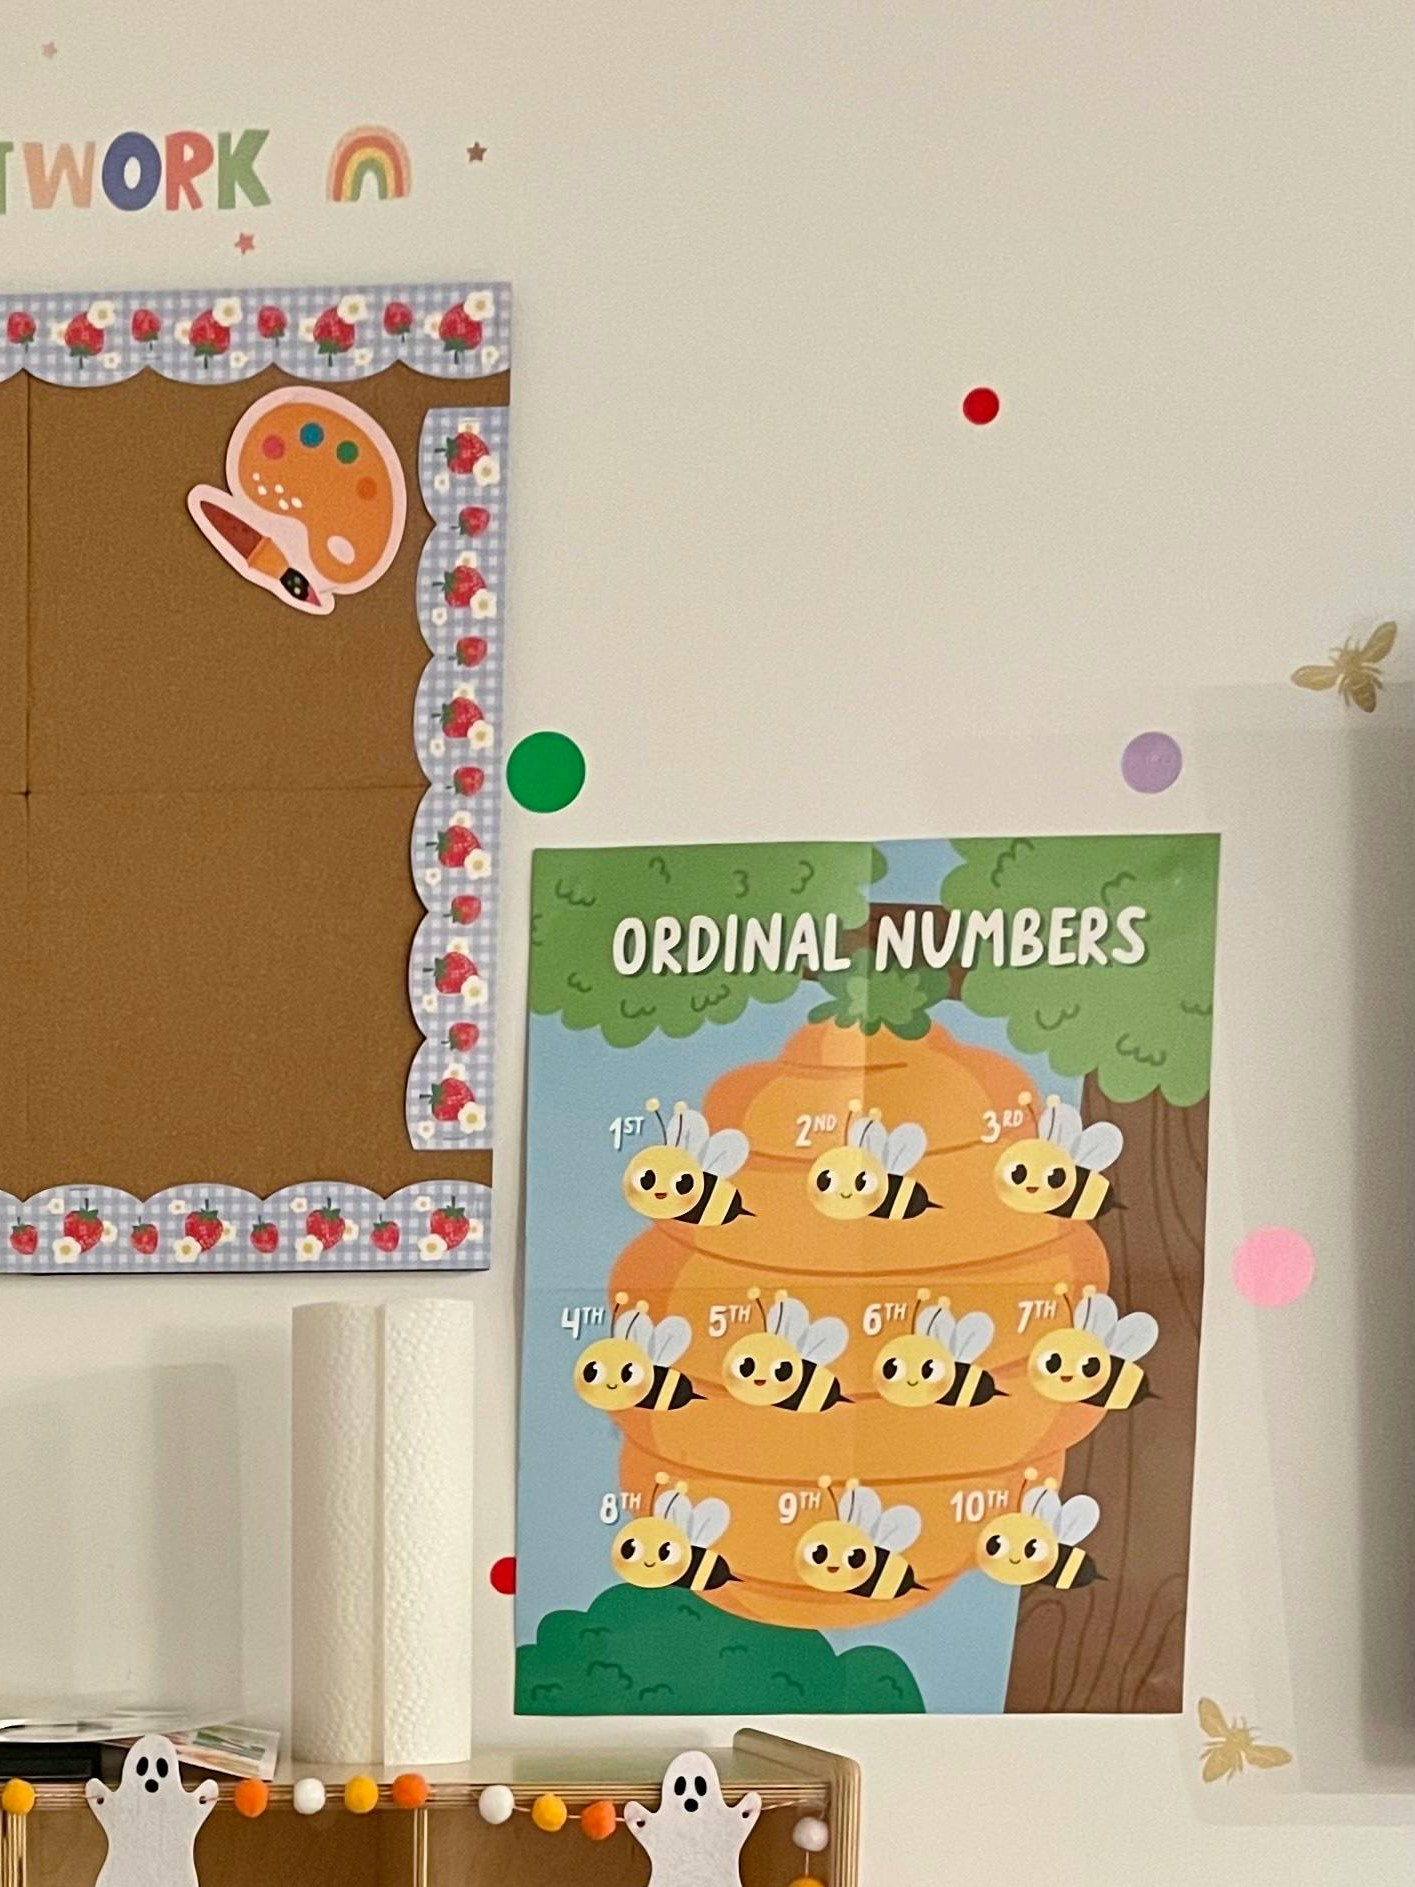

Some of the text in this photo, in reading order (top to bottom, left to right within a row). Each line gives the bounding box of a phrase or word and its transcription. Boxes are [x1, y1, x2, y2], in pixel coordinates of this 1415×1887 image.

[612, 906, 1147, 975] ORDINAL NUMBERS
[609, 1116, 645, 1151] 1ST
[794, 1114, 837, 1147] 2ND
[980, 1110, 1024, 1144] 3RD
[561, 1306, 605, 1340] 4TH
[708, 1304, 751, 1338] 5TH
[862, 1303, 908, 1336] 6TH
[1017, 1300, 1057, 1334] 7TH
[599, 1492, 642, 1524] 8TH
[778, 1491, 822, 1524] 9TH
[950, 1489, 1009, 1522] 10TH
